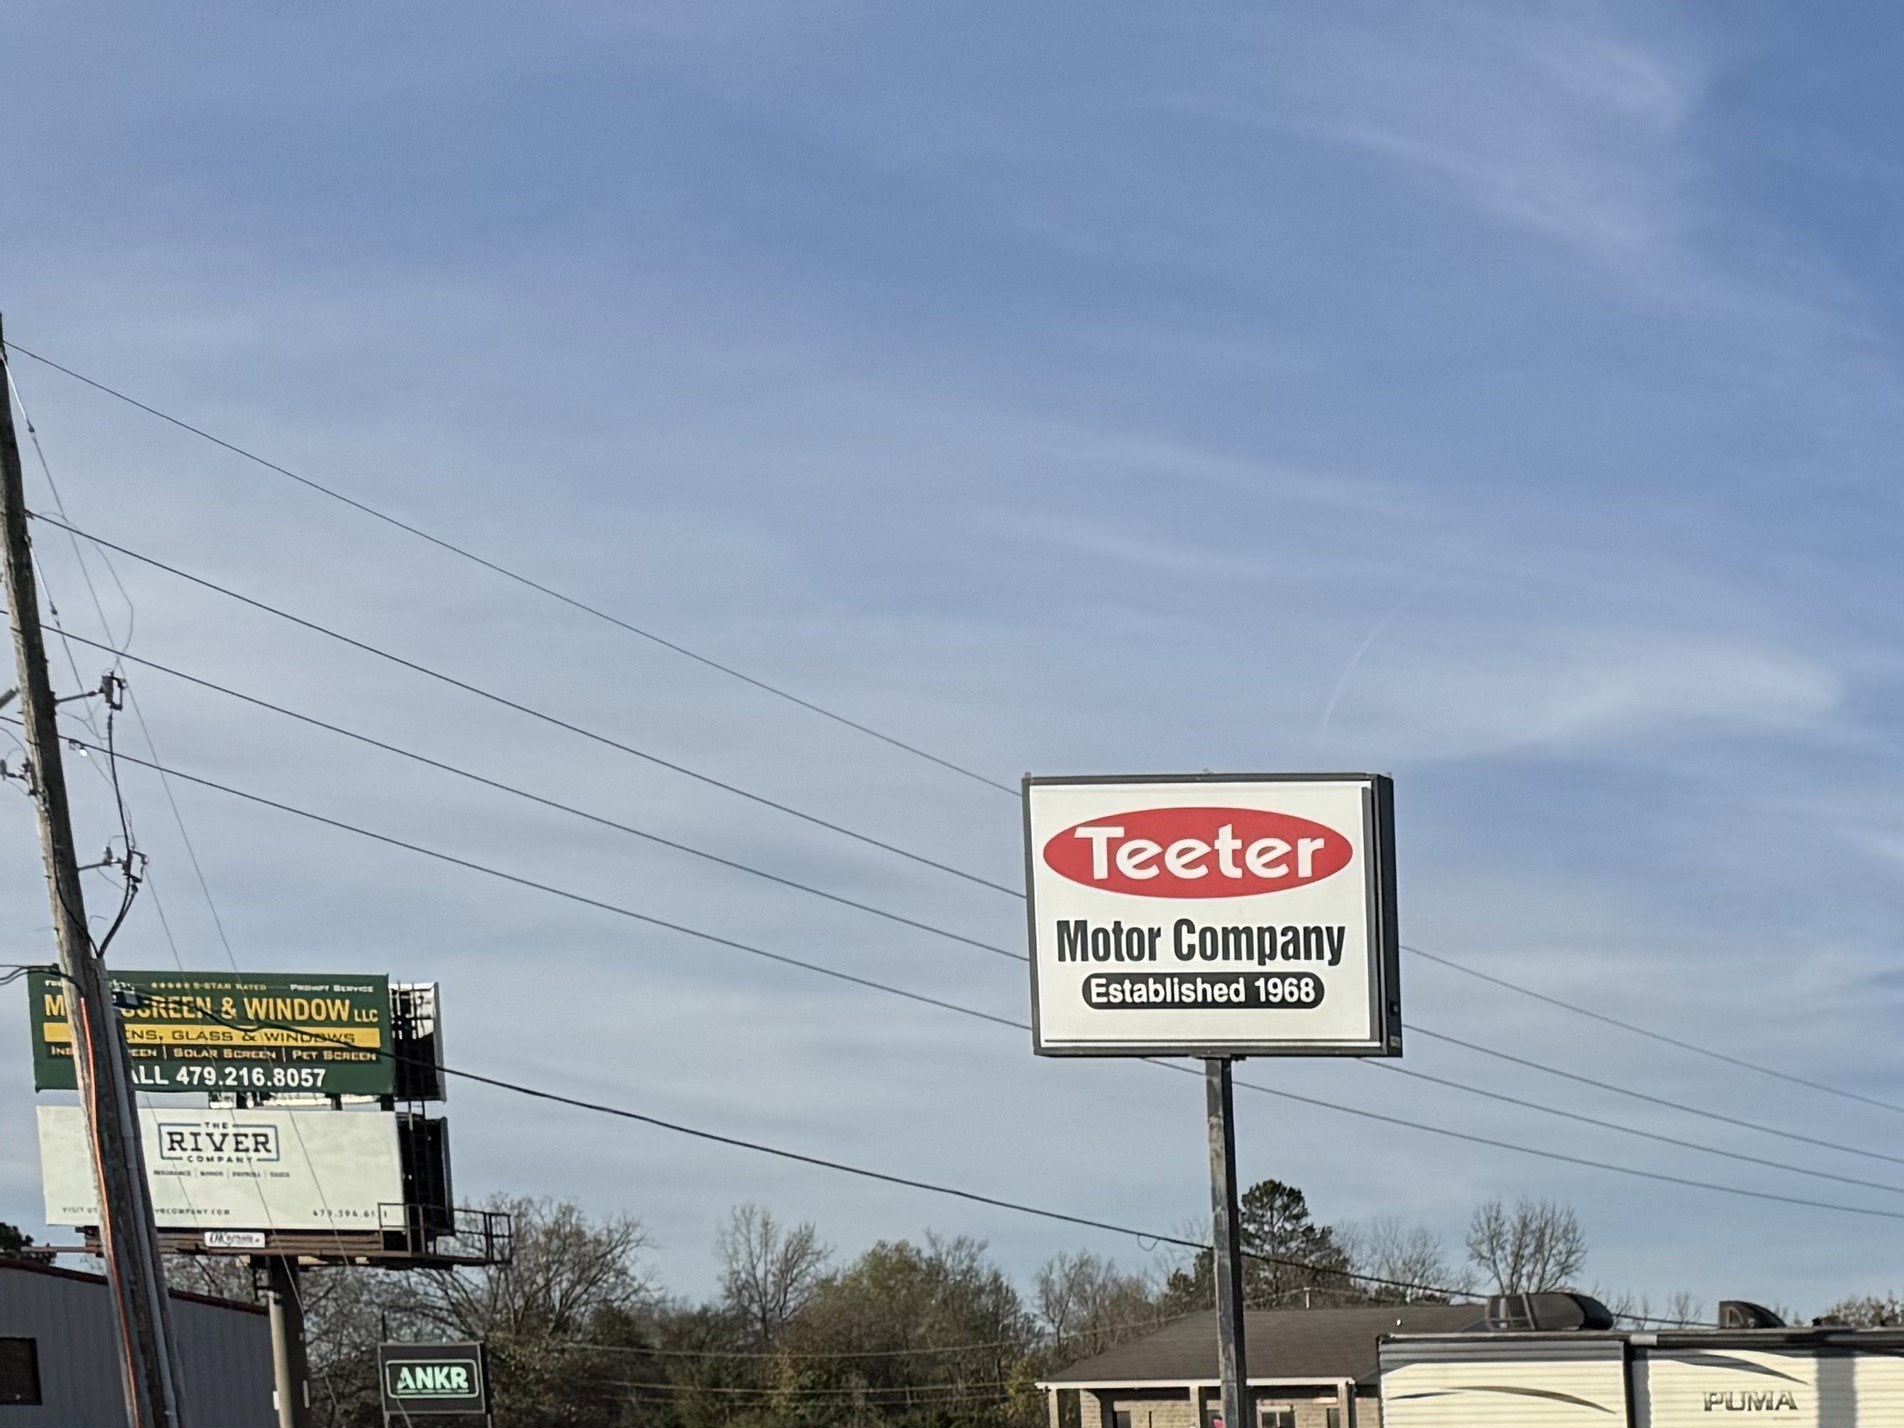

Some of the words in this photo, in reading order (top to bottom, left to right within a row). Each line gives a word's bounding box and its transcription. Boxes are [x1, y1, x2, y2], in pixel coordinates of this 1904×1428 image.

[1074, 822, 1325, 881] Teeter
[1056, 919, 1162, 962] Motor
[1173, 918, 1346, 967] Company
[1090, 976, 1246, 1004] Established
[1255, 976, 1316, 1003] 1968
[221, 997, 237, 1019] &
[244, 997, 350, 1022] WINDOW
[354, 1009, 379, 1022] LLC
[172, 1030, 233, 1042] GLASS
[264, 1031, 356, 1044] WINDOWS
[176, 1066, 326, 1087] 479.216.8057
[166, 1131, 272, 1153] RIVER
[187, 1155, 253, 1164] COMPANY
[397, 1366, 469, 1389] ANKR
[1703, 1389, 1799, 1412] PUMA
